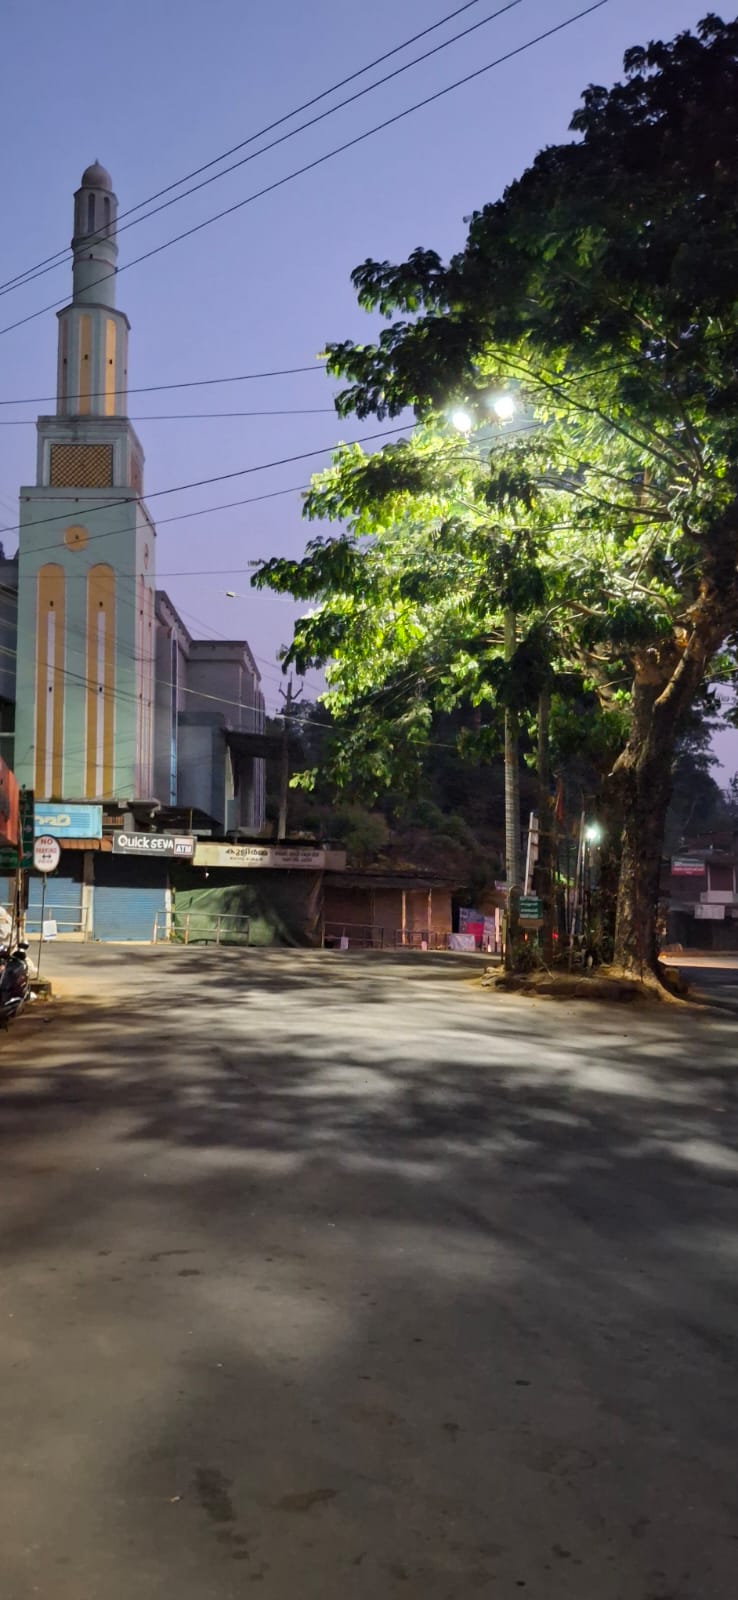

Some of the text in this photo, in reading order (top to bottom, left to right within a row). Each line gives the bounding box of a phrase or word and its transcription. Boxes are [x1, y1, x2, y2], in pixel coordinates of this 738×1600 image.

[118, 834, 173, 849] Quick SEVA
[176, 845, 192, 853] ATM
